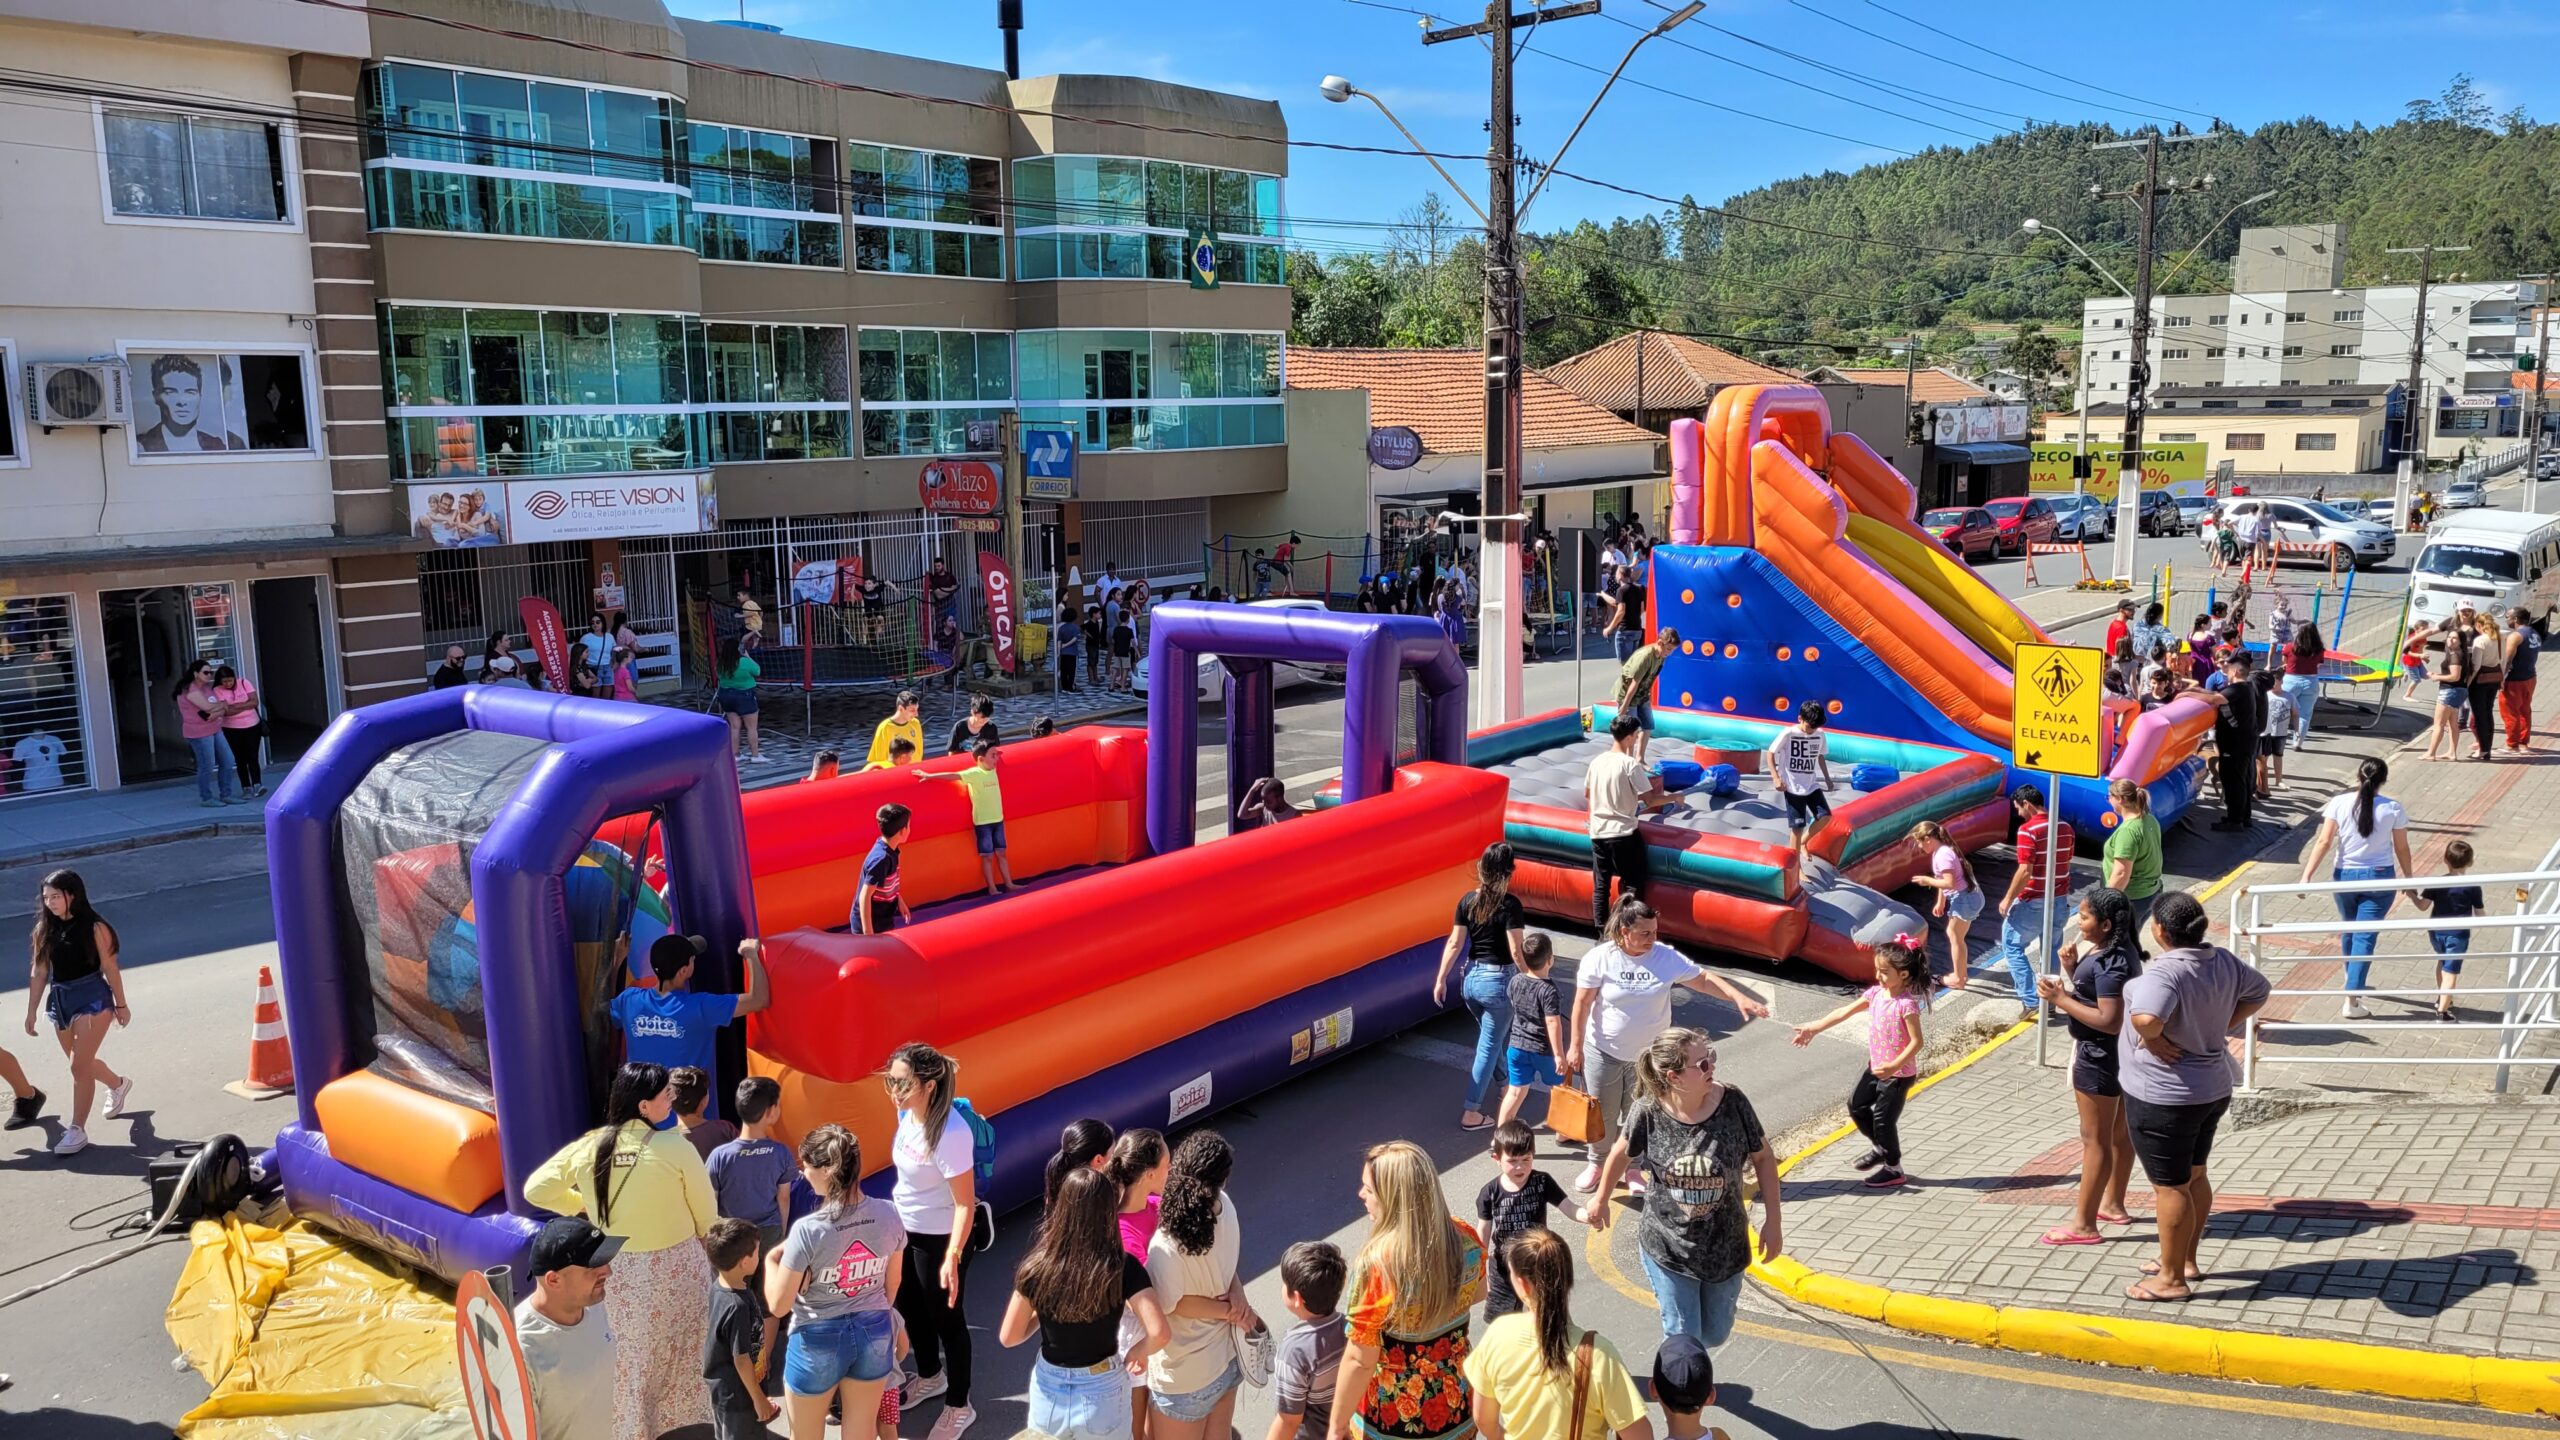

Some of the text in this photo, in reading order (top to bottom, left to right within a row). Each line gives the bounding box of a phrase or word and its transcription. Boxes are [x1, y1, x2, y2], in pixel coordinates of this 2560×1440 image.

[1374, 435, 1413, 449] STYLUS
[2030, 451, 2071, 465] REÇO
[2106, 450, 2185, 462] ERGIA
[950, 467, 988, 492] Mazo
[2030, 472, 2057, 482] AIXA
[1030, 480, 1068, 493] CORREIOS
[571, 486, 685, 509] FREE VISION
[571, 505, 596, 520] Ótica,
[597, 504, 637, 519] Relojoaria
[644, 504, 686, 516] Perfumaria
[989, 570, 1012, 652] ÓTICA
[542, 610, 556, 641] AGENDE
[2034, 710, 2079, 725] FAIXA
[2021, 727, 2091, 745] ELEVADA
[1791, 740, 1809, 758] BE
[1790, 758, 1816, 770] BRAV
[740, 1146, 774, 1157] FLASH
[1674, 1155, 1713, 1177] STAY
[1665, 1174, 1724, 1189] STRONG
